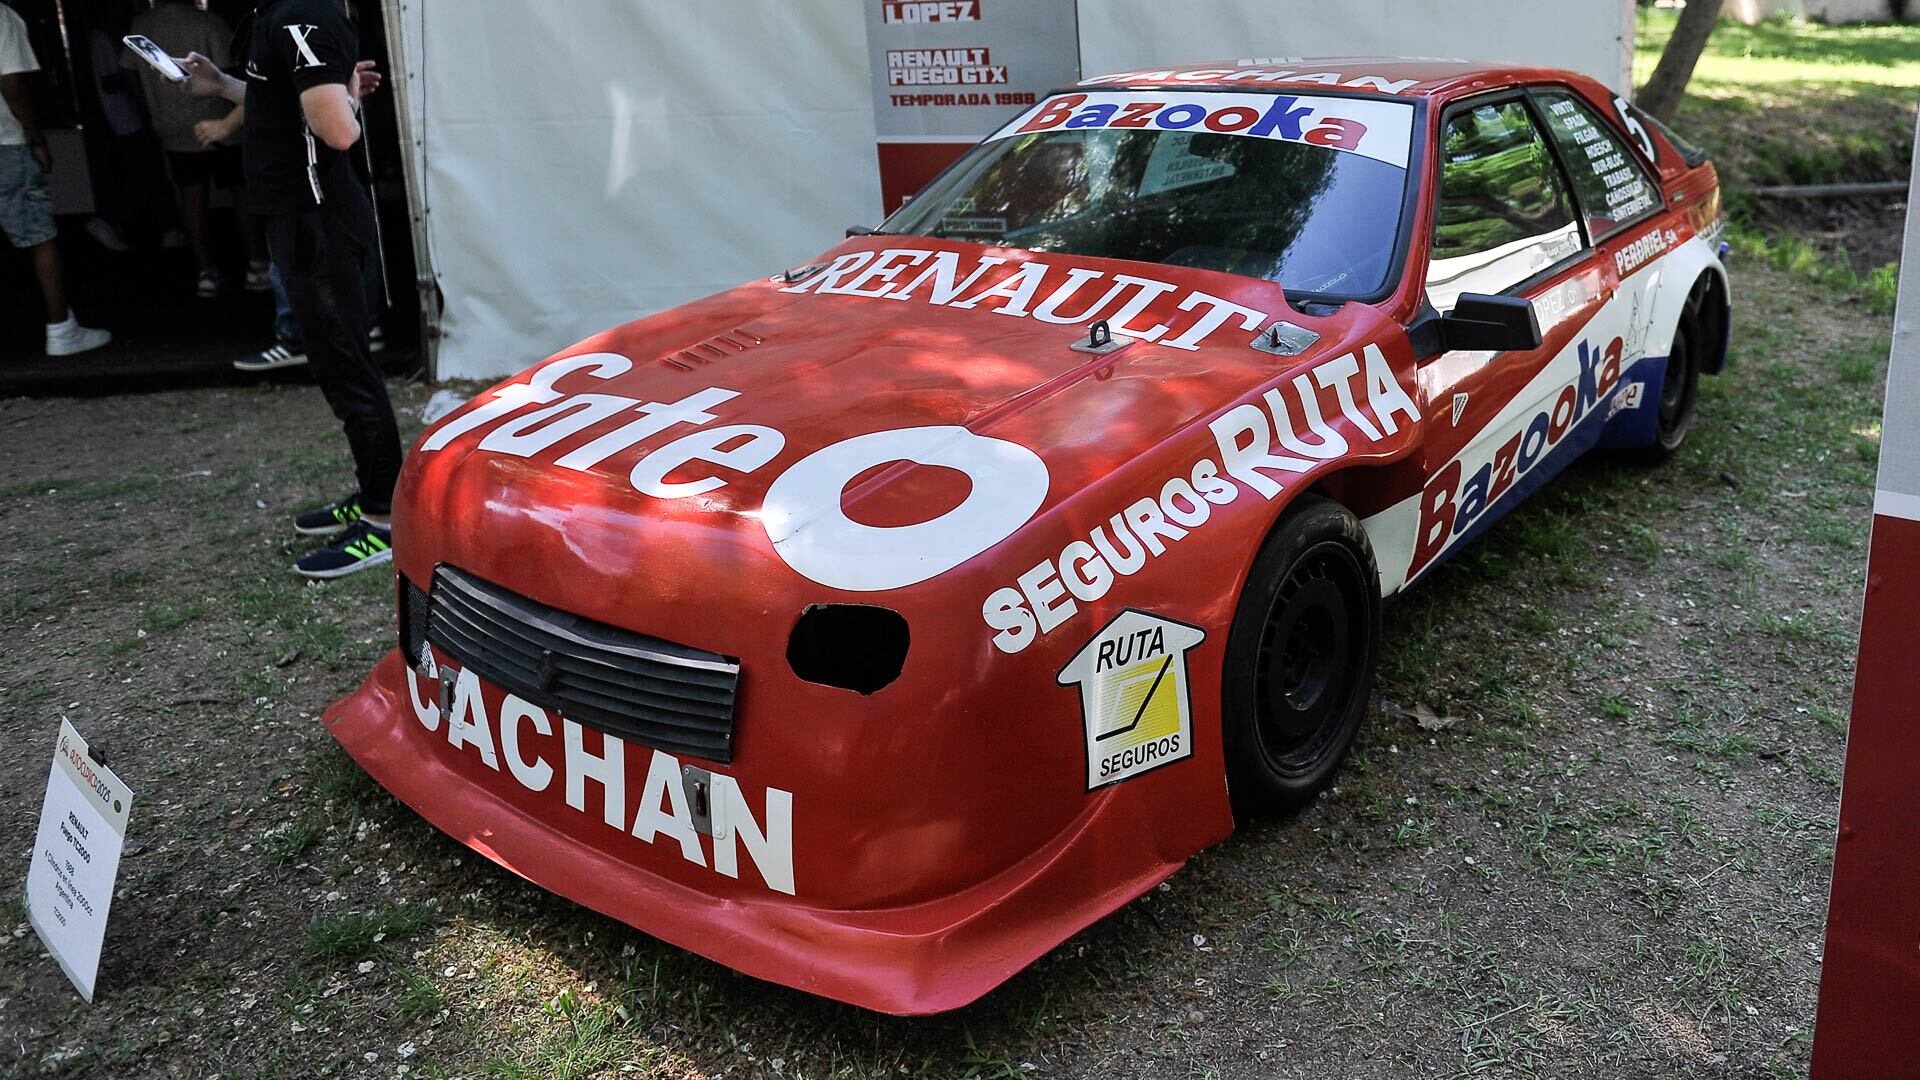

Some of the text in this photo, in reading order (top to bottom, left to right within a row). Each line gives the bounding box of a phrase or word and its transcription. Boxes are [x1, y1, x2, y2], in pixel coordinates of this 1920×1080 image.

[884, 2, 974, 25] LOPEZ
[282, 23, 327, 73] X
[887, 49, 985, 68] RENAULT
[889, 66, 1006, 85] FUEGO GTX
[889, 92, 1036, 107] TEMPORADA 1988
[1075, 68, 1420, 96] CACHAN
[1013, 93, 1369, 151] Bazooka
[1614, 228, 1668, 276] PERDRIEL
[780, 248, 1269, 352] RENAULT
[1534, 292, 1566, 323] OPEZ
[420, 352, 787, 500] fate
[1404, 336, 1624, 584] Bazooka
[981, 458, 1240, 655] SEGUROS
[1208, 342, 1422, 501] RUTA
[1095, 625, 1165, 674] RUTA
[406, 642, 796, 897] CACHAN
[1099, 734, 1181, 778] SEGUROS
[68, 810, 89, 840] RENAULT
